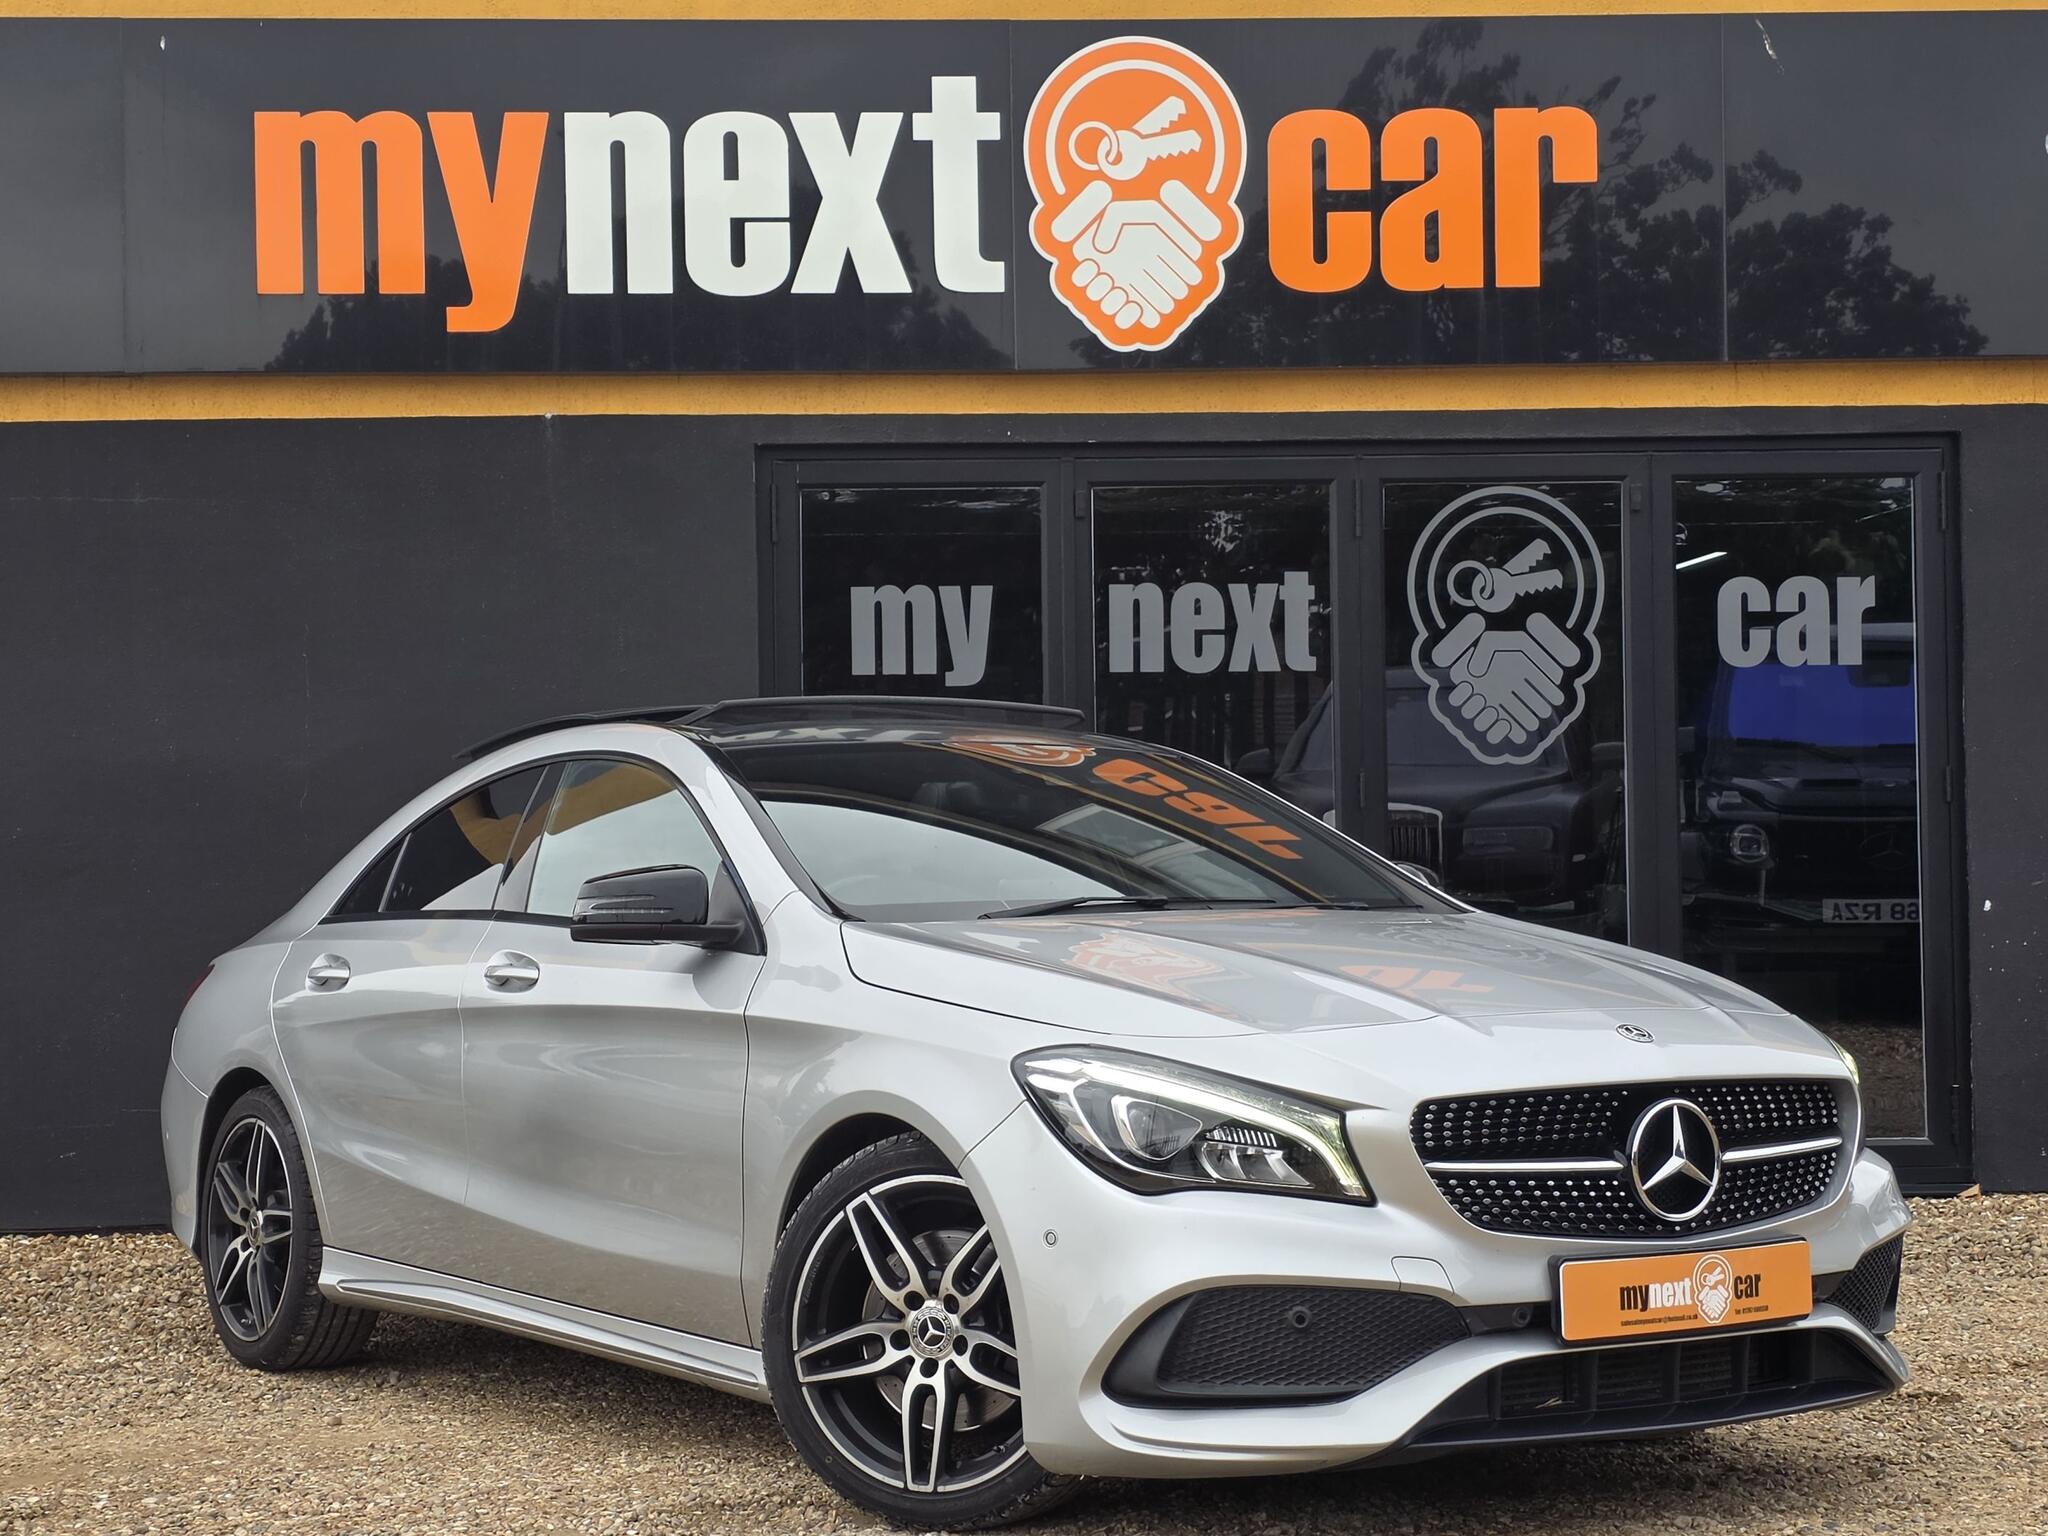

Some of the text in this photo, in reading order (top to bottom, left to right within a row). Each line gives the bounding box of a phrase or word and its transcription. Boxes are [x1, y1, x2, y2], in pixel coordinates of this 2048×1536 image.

[1267, 106, 1598, 292] car
[850, 571, 1876, 687] my next car
[1733, 1272, 1762, 1301] car
